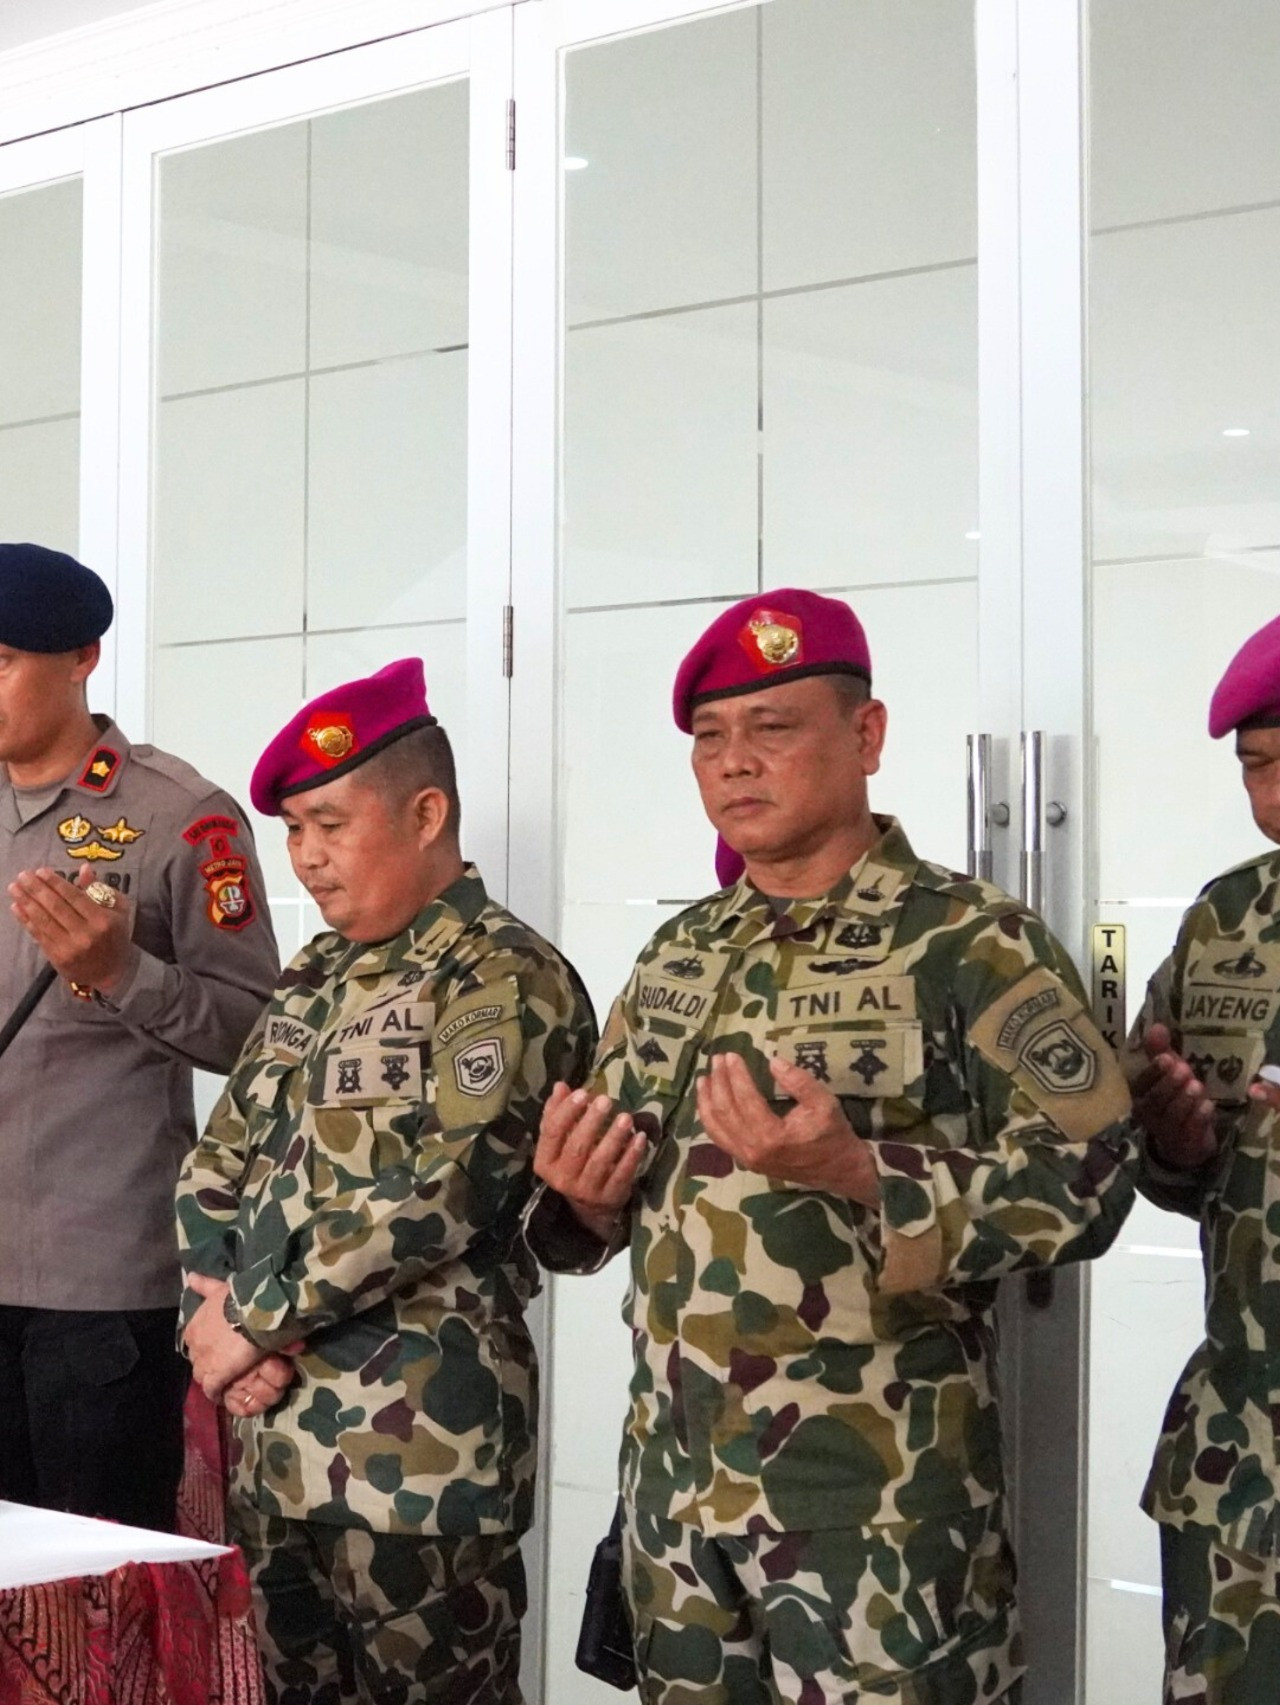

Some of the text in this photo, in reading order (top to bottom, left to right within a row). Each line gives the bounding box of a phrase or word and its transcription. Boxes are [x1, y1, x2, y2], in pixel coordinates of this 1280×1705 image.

[640, 984, 708, 1019] SUDALDI
[789, 985, 902, 1019] TNI AL
[1100, 929, 1119, 1049] TARIK
[339, 1007, 424, 1043] TNI AL
[1185, 995, 1270, 1021] JAYENG
[441, 1018, 465, 1039] MAKO
